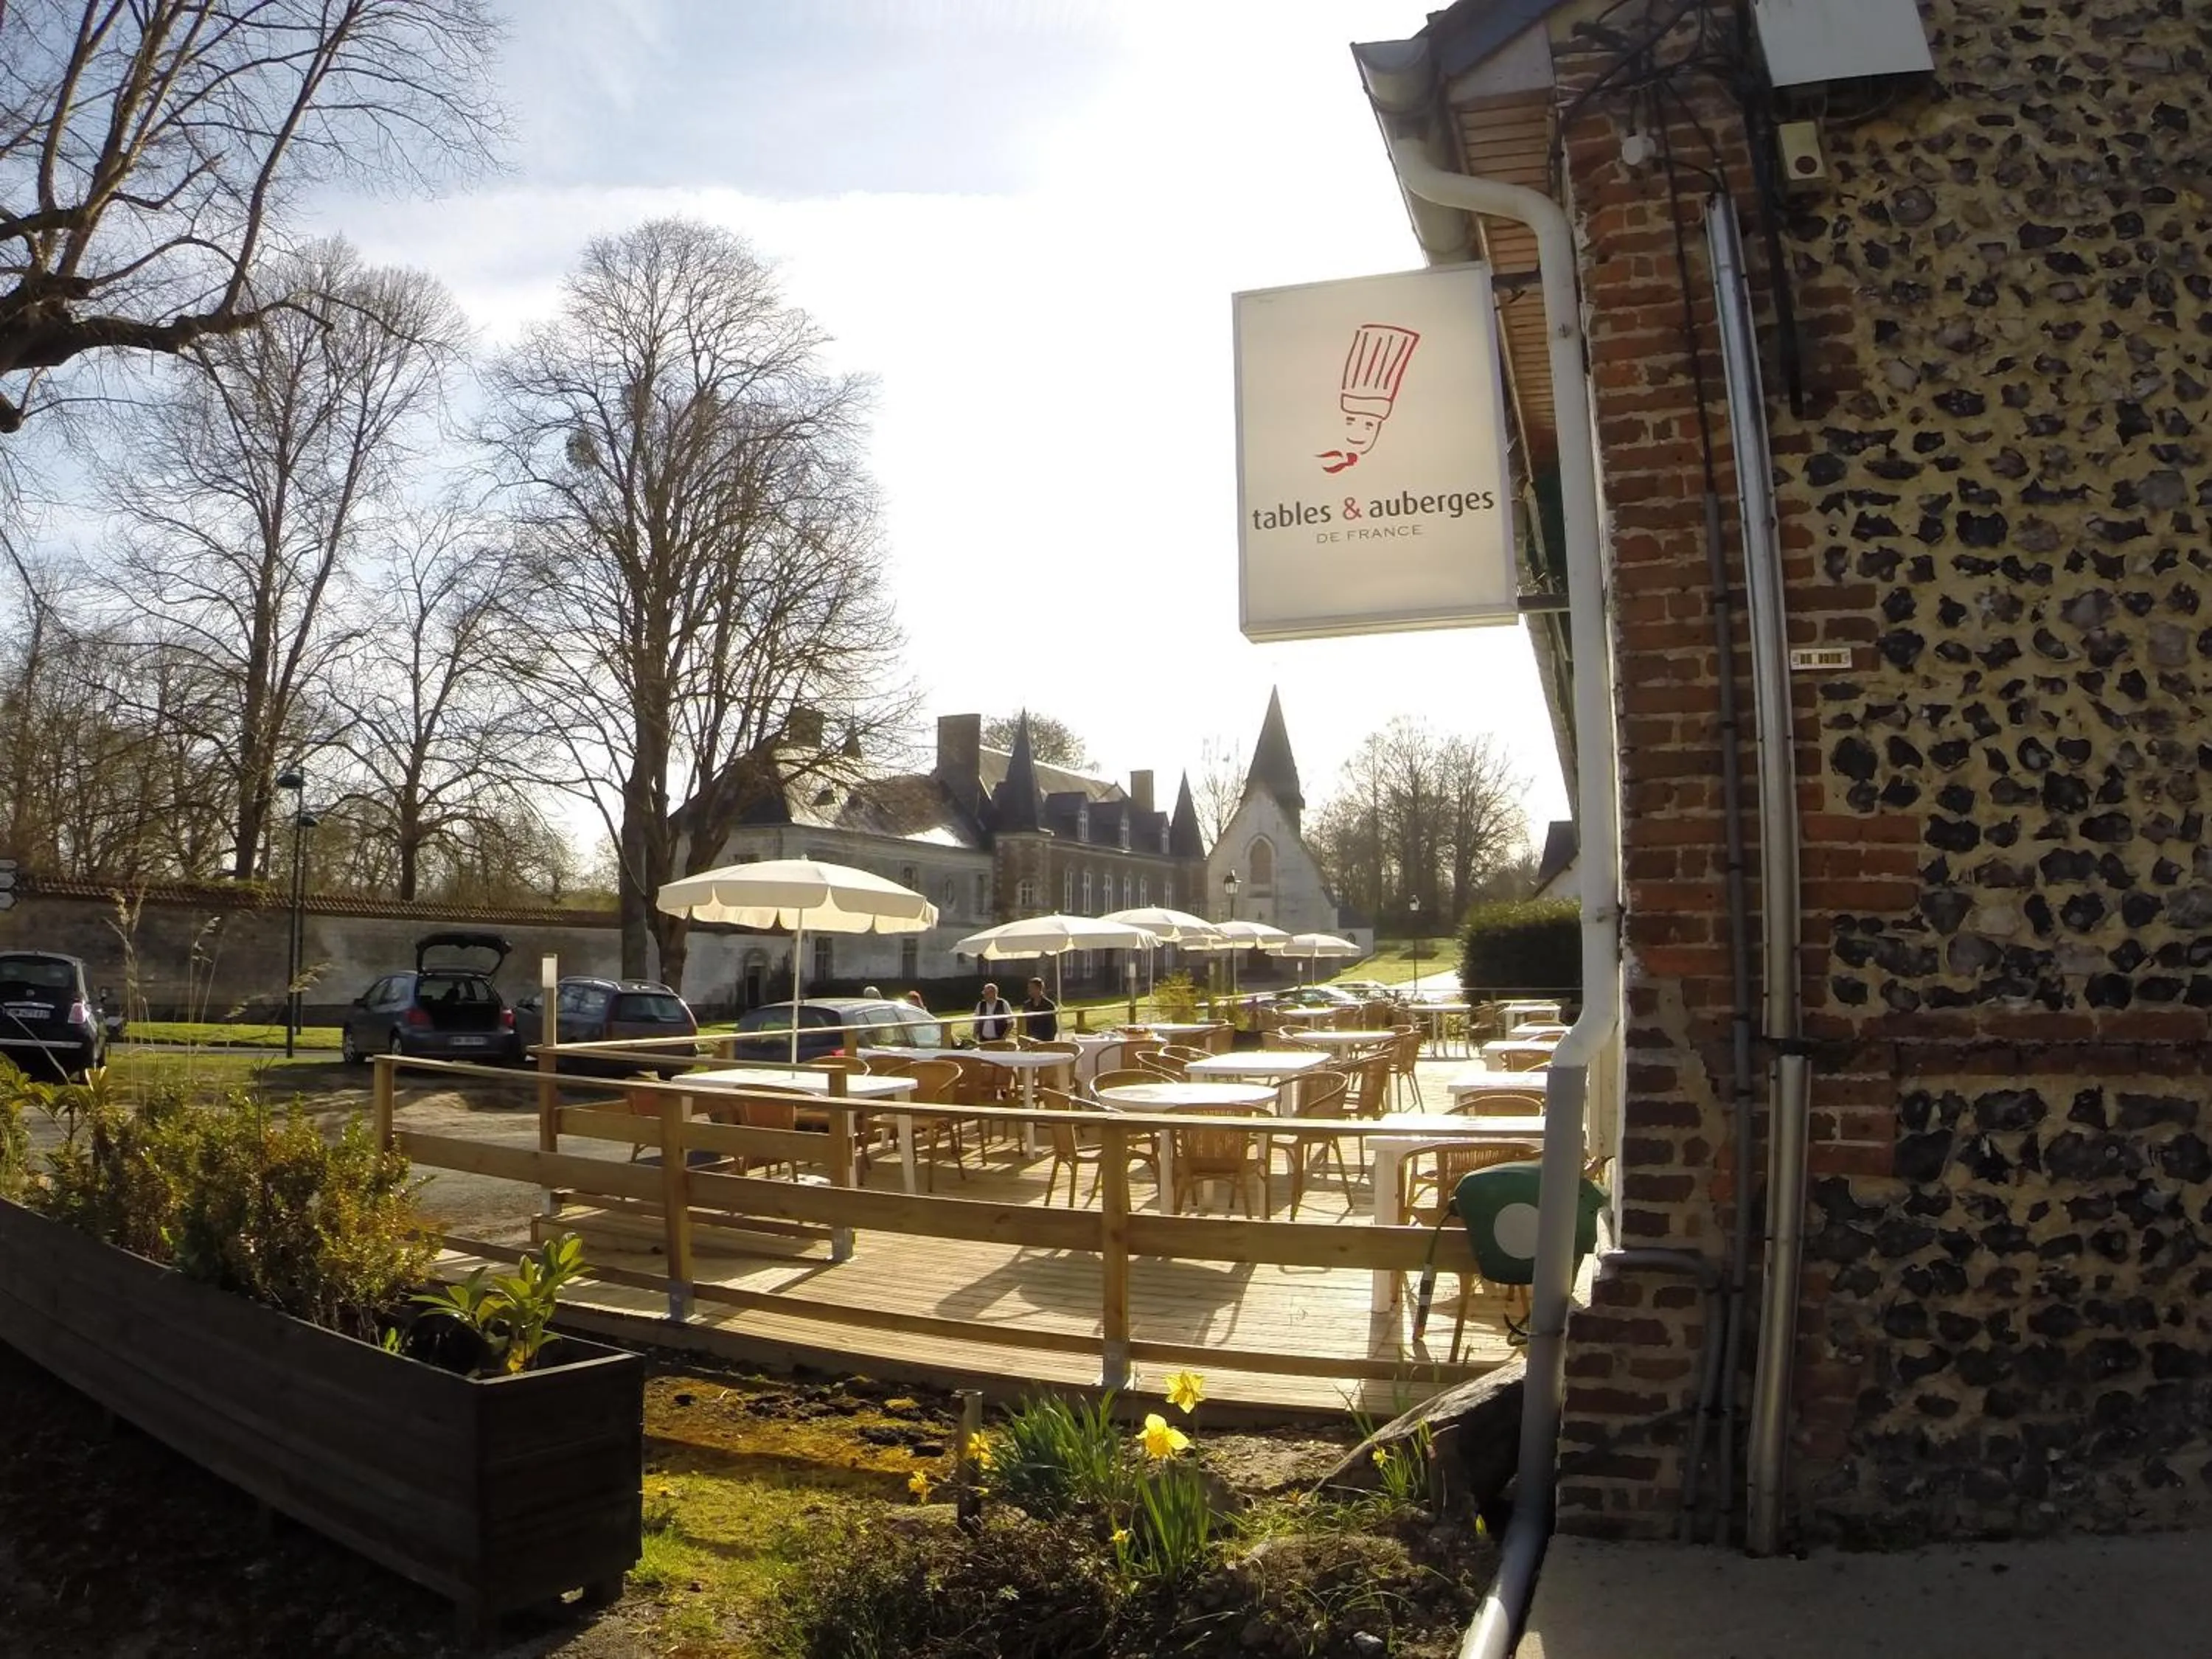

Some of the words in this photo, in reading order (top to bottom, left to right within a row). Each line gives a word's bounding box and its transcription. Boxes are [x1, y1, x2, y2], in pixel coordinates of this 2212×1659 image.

[1253, 501, 1332, 529] tables
[1343, 496, 1362, 521] &
[1369, 490, 1495, 518] auberges
[1316, 532, 1340, 543] DE
[1346, 524, 1424, 540] FRANCE
